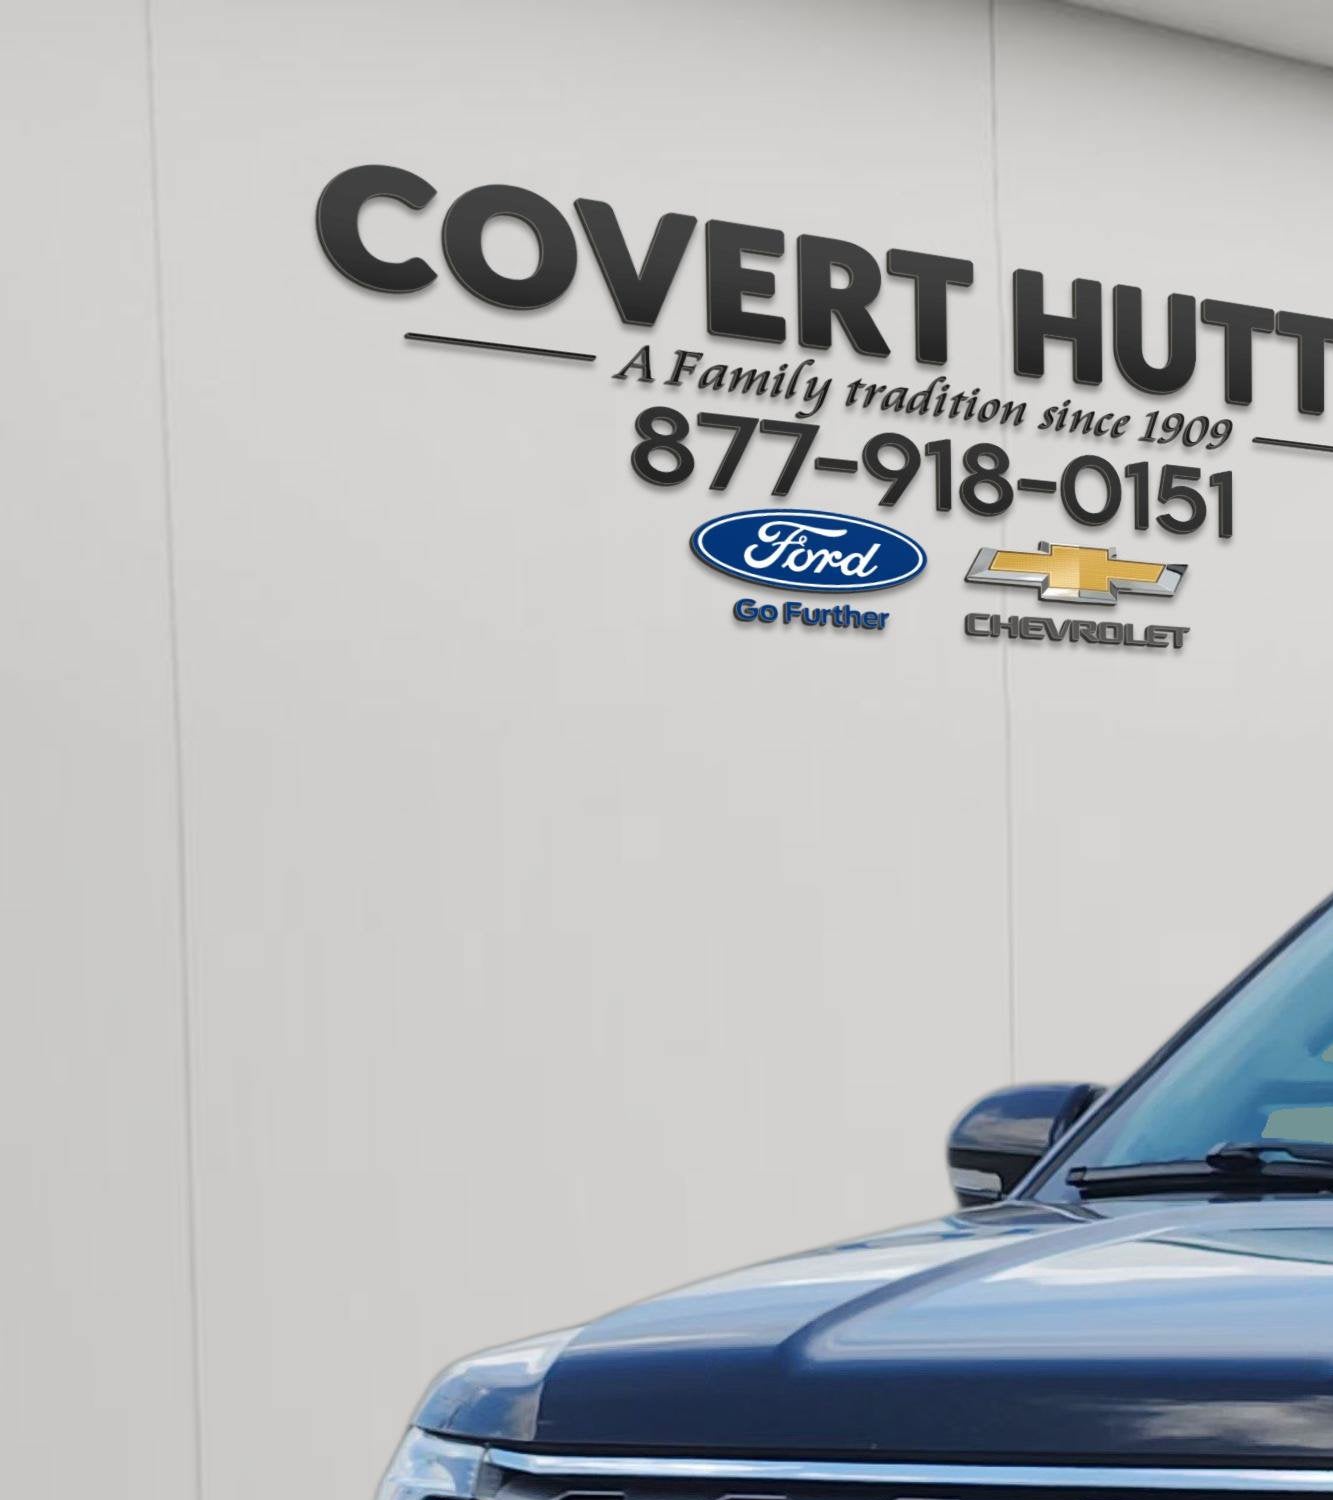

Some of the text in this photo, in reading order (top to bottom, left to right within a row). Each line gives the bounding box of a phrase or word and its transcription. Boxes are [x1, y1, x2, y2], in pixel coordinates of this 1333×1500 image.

[315, 164, 974, 366] COVERT
[612, 344, 1234, 451] A Family tradition since 1909
[630, 406, 1234, 539] 877-918-0151
[743, 520, 882, 578] Ford
[733, 598, 890, 631] Go Further
[964, 612, 1191, 649] CHEVROLET
